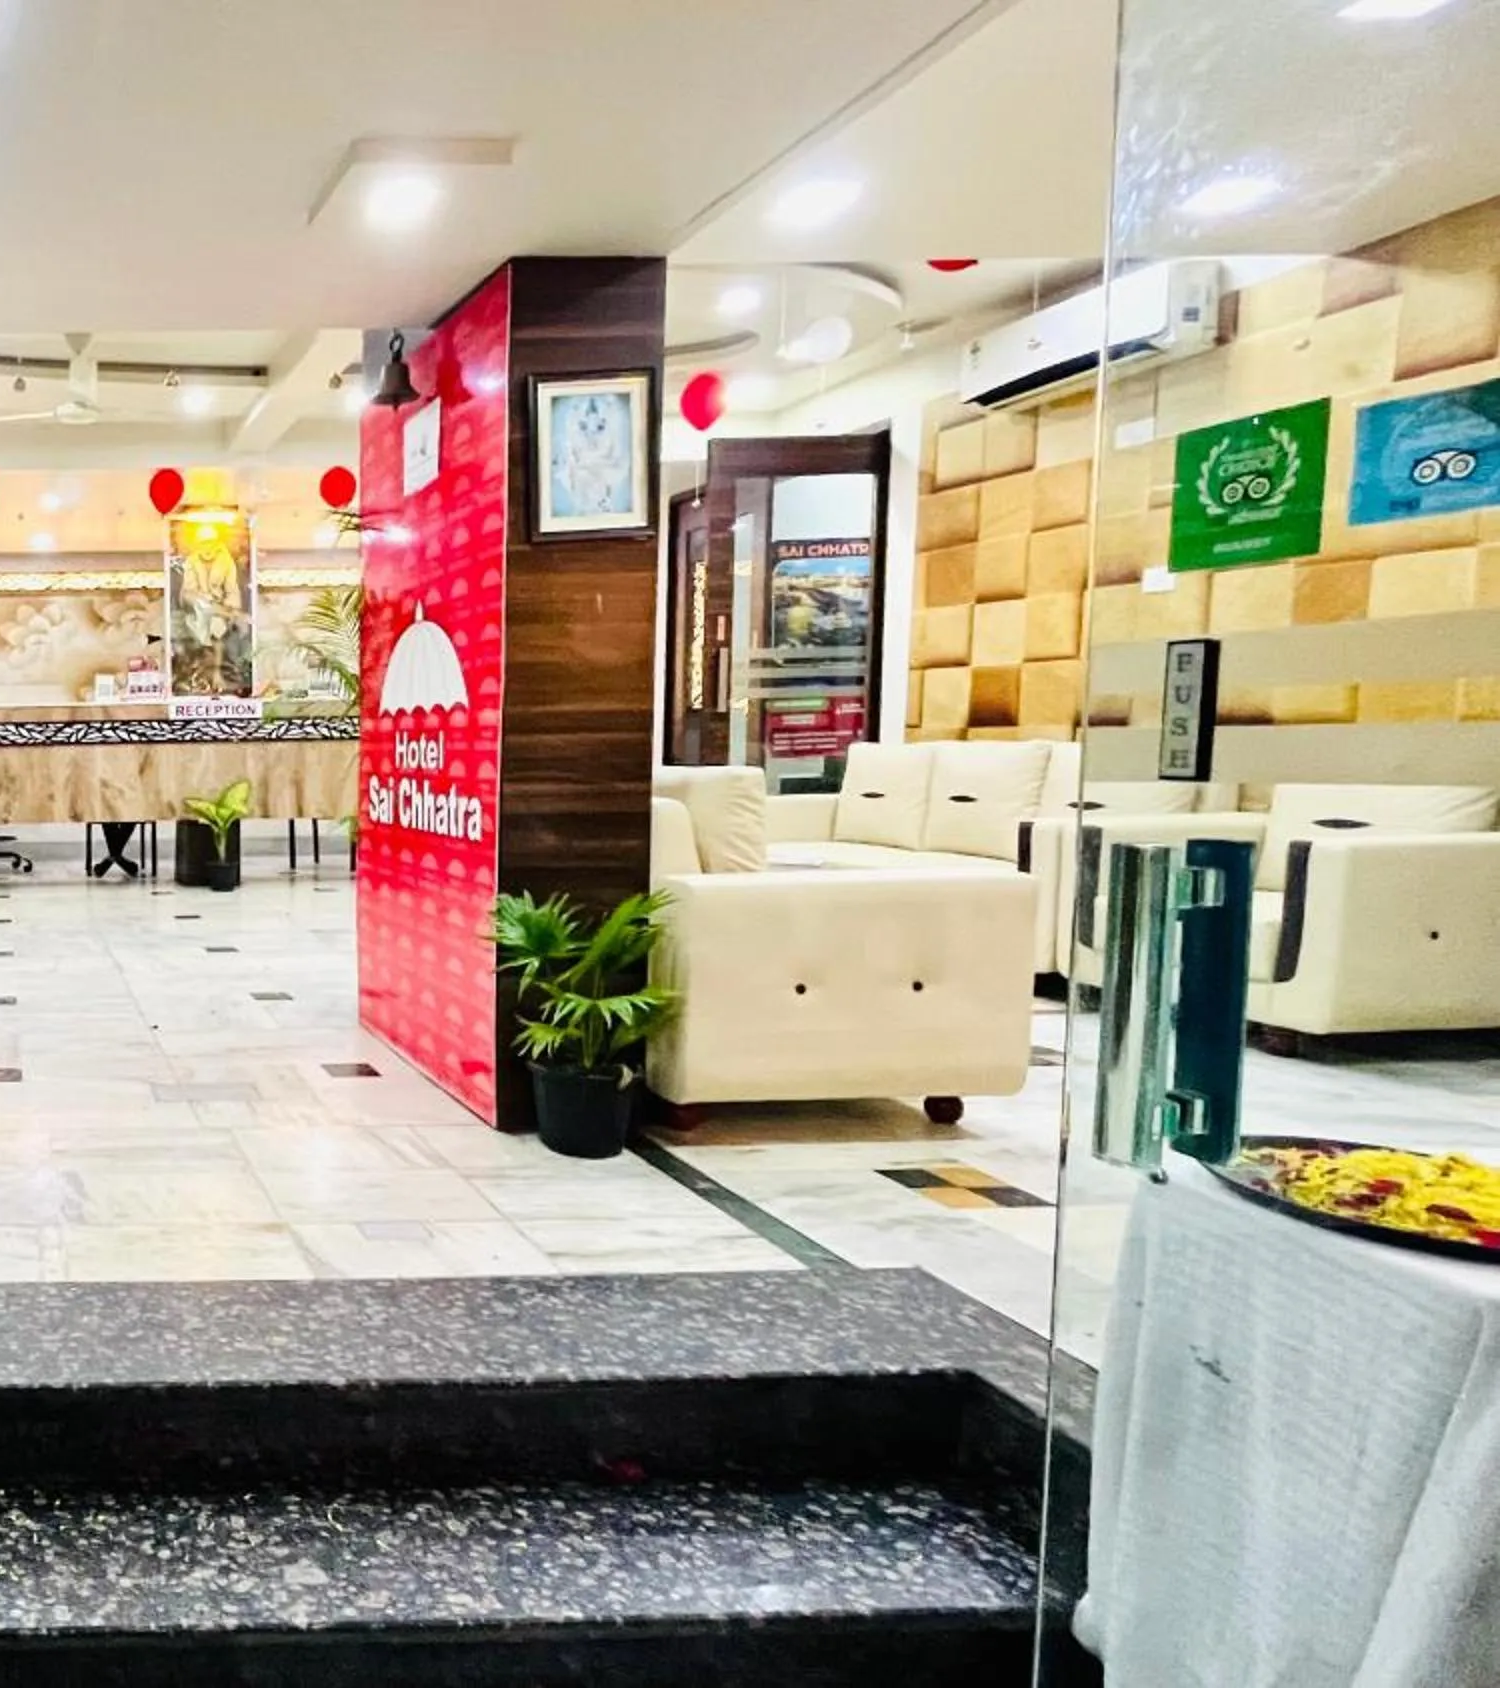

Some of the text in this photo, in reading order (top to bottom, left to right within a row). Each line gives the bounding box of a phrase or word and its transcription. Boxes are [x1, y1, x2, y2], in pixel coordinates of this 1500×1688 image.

[778, 544, 804, 557] SAI
[175, 704, 257, 717] RECEPTION
[395, 730, 445, 770] Hotel
[369, 774, 482, 842] Sai Chhatra
